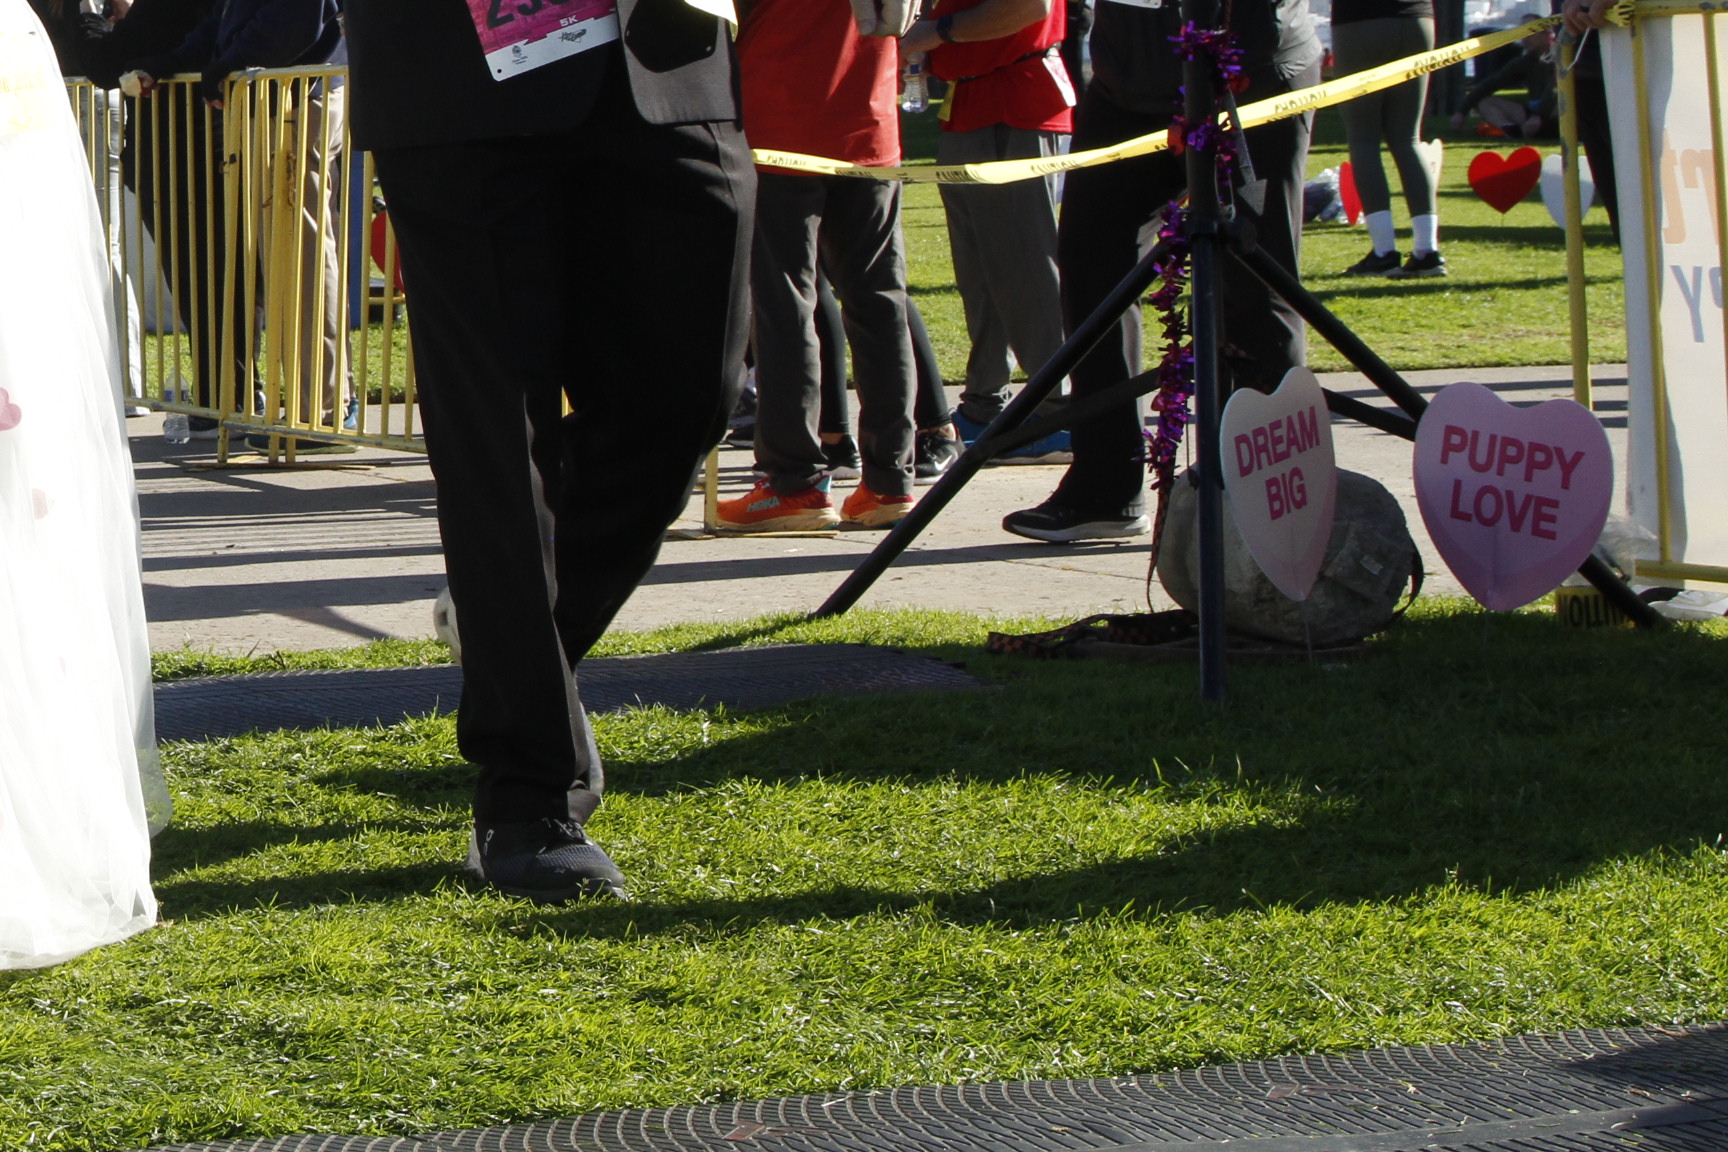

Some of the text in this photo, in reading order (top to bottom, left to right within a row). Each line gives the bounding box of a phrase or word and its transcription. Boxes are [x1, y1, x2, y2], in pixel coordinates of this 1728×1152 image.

[559, 14, 579, 27] 5K
[1234, 405, 1321, 478] DREAM
[1439, 424, 1585, 491] PUPPY
[1265, 466, 1308, 521] BIG
[1449, 478, 1560, 541] LOVE
